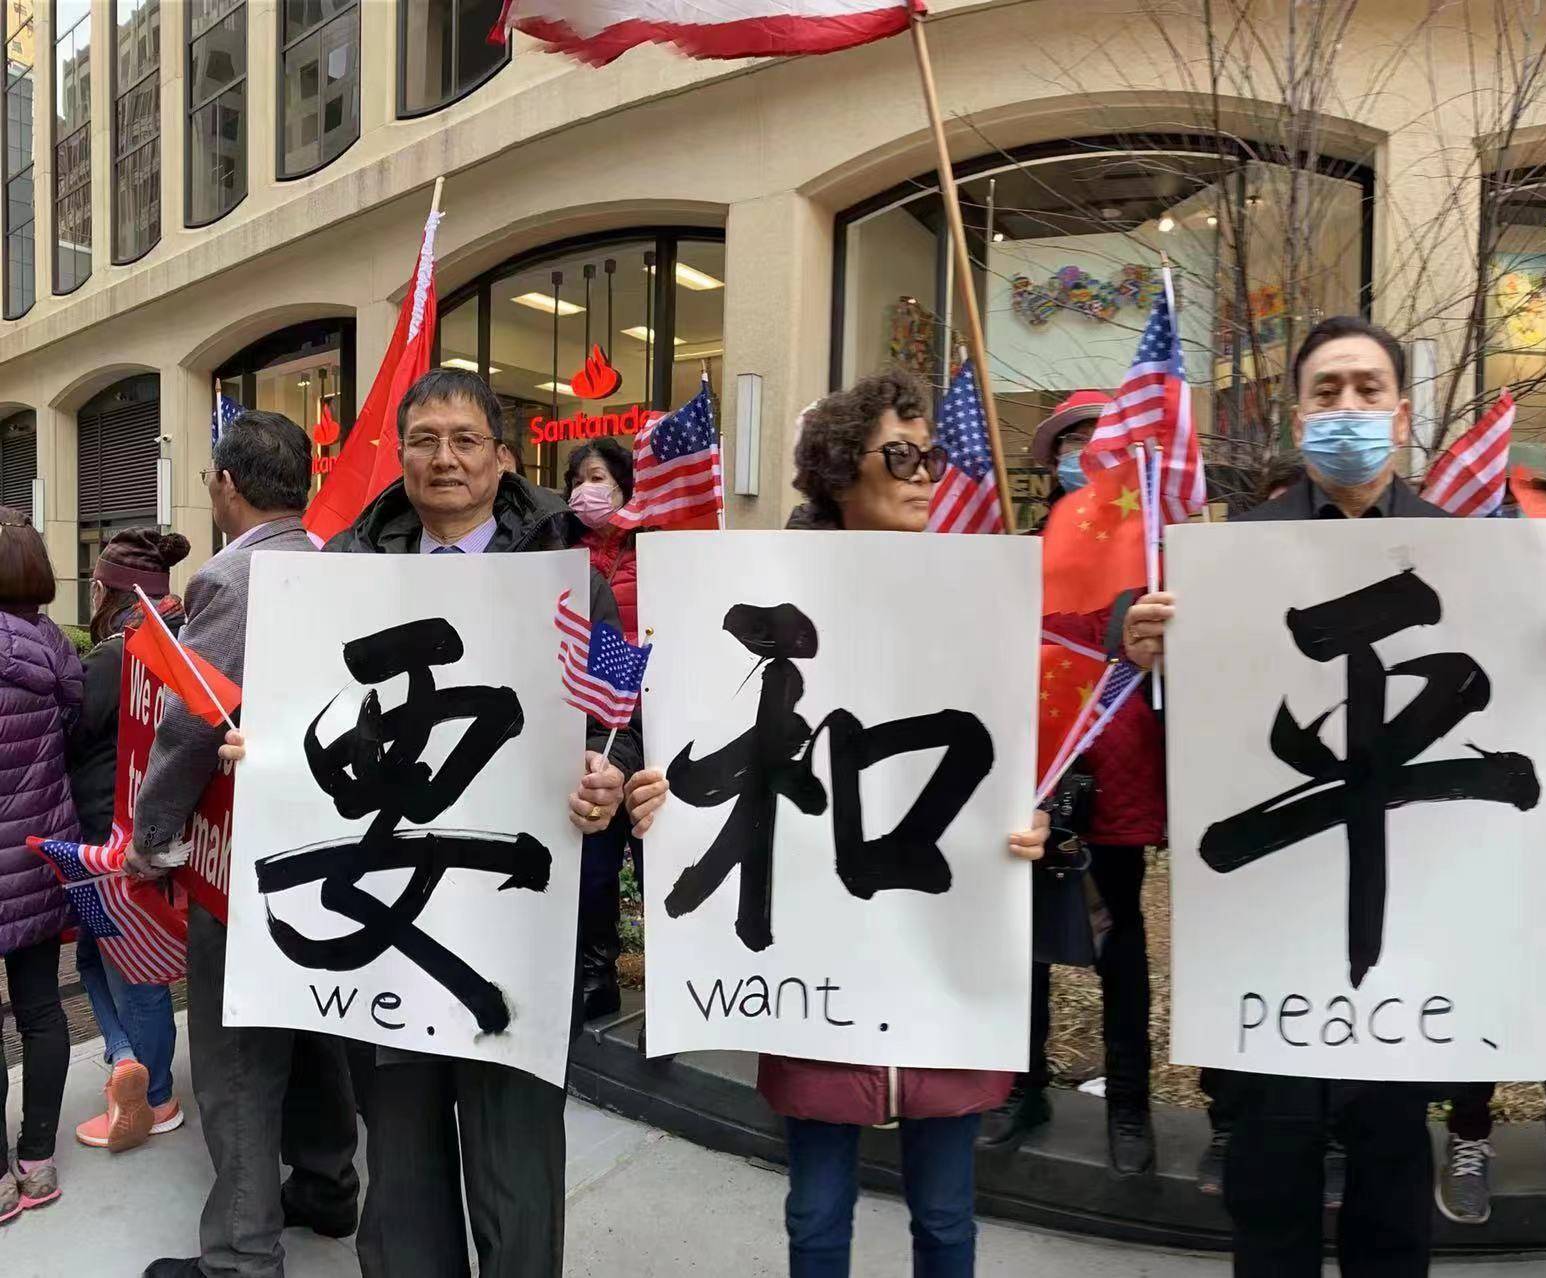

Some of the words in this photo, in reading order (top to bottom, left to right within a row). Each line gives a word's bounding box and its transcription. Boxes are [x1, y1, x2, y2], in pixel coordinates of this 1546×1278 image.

[130, 655, 150, 726] We
[664, 602, 995, 953] 和
[1198, 567, 1541, 990] 平
[254, 617, 552, 1035] 要
[309, 984, 435, 1036] we.
[686, 975, 890, 1032] want.
